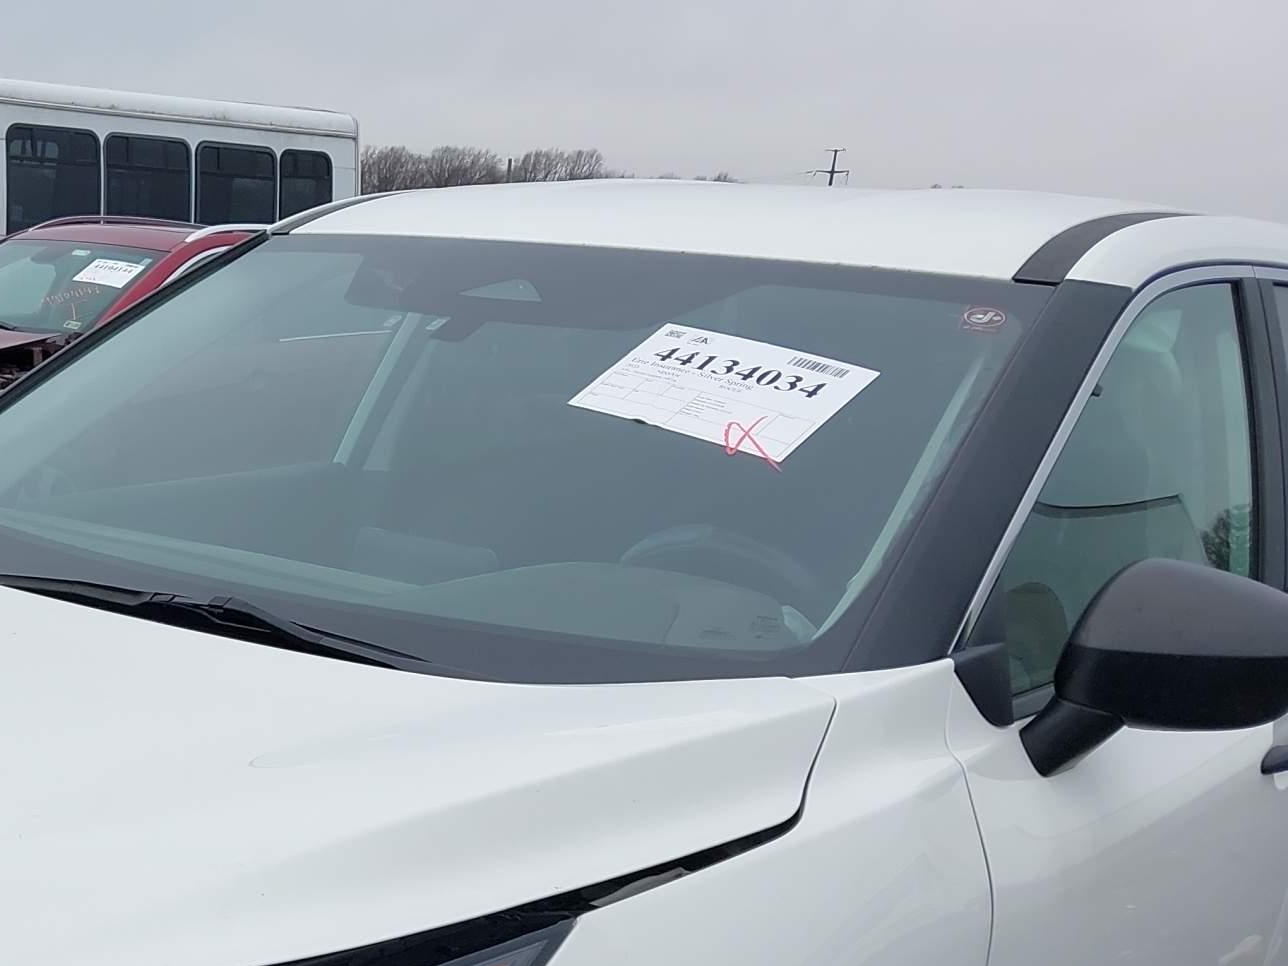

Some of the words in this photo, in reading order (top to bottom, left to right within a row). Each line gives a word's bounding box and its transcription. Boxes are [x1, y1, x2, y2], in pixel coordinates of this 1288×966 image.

[650, 358, 691, 375] Insurance
[698, 371, 723, 382] Silver
[724, 377, 755, 391] Spring
[654, 347, 827, 399] 44134034
